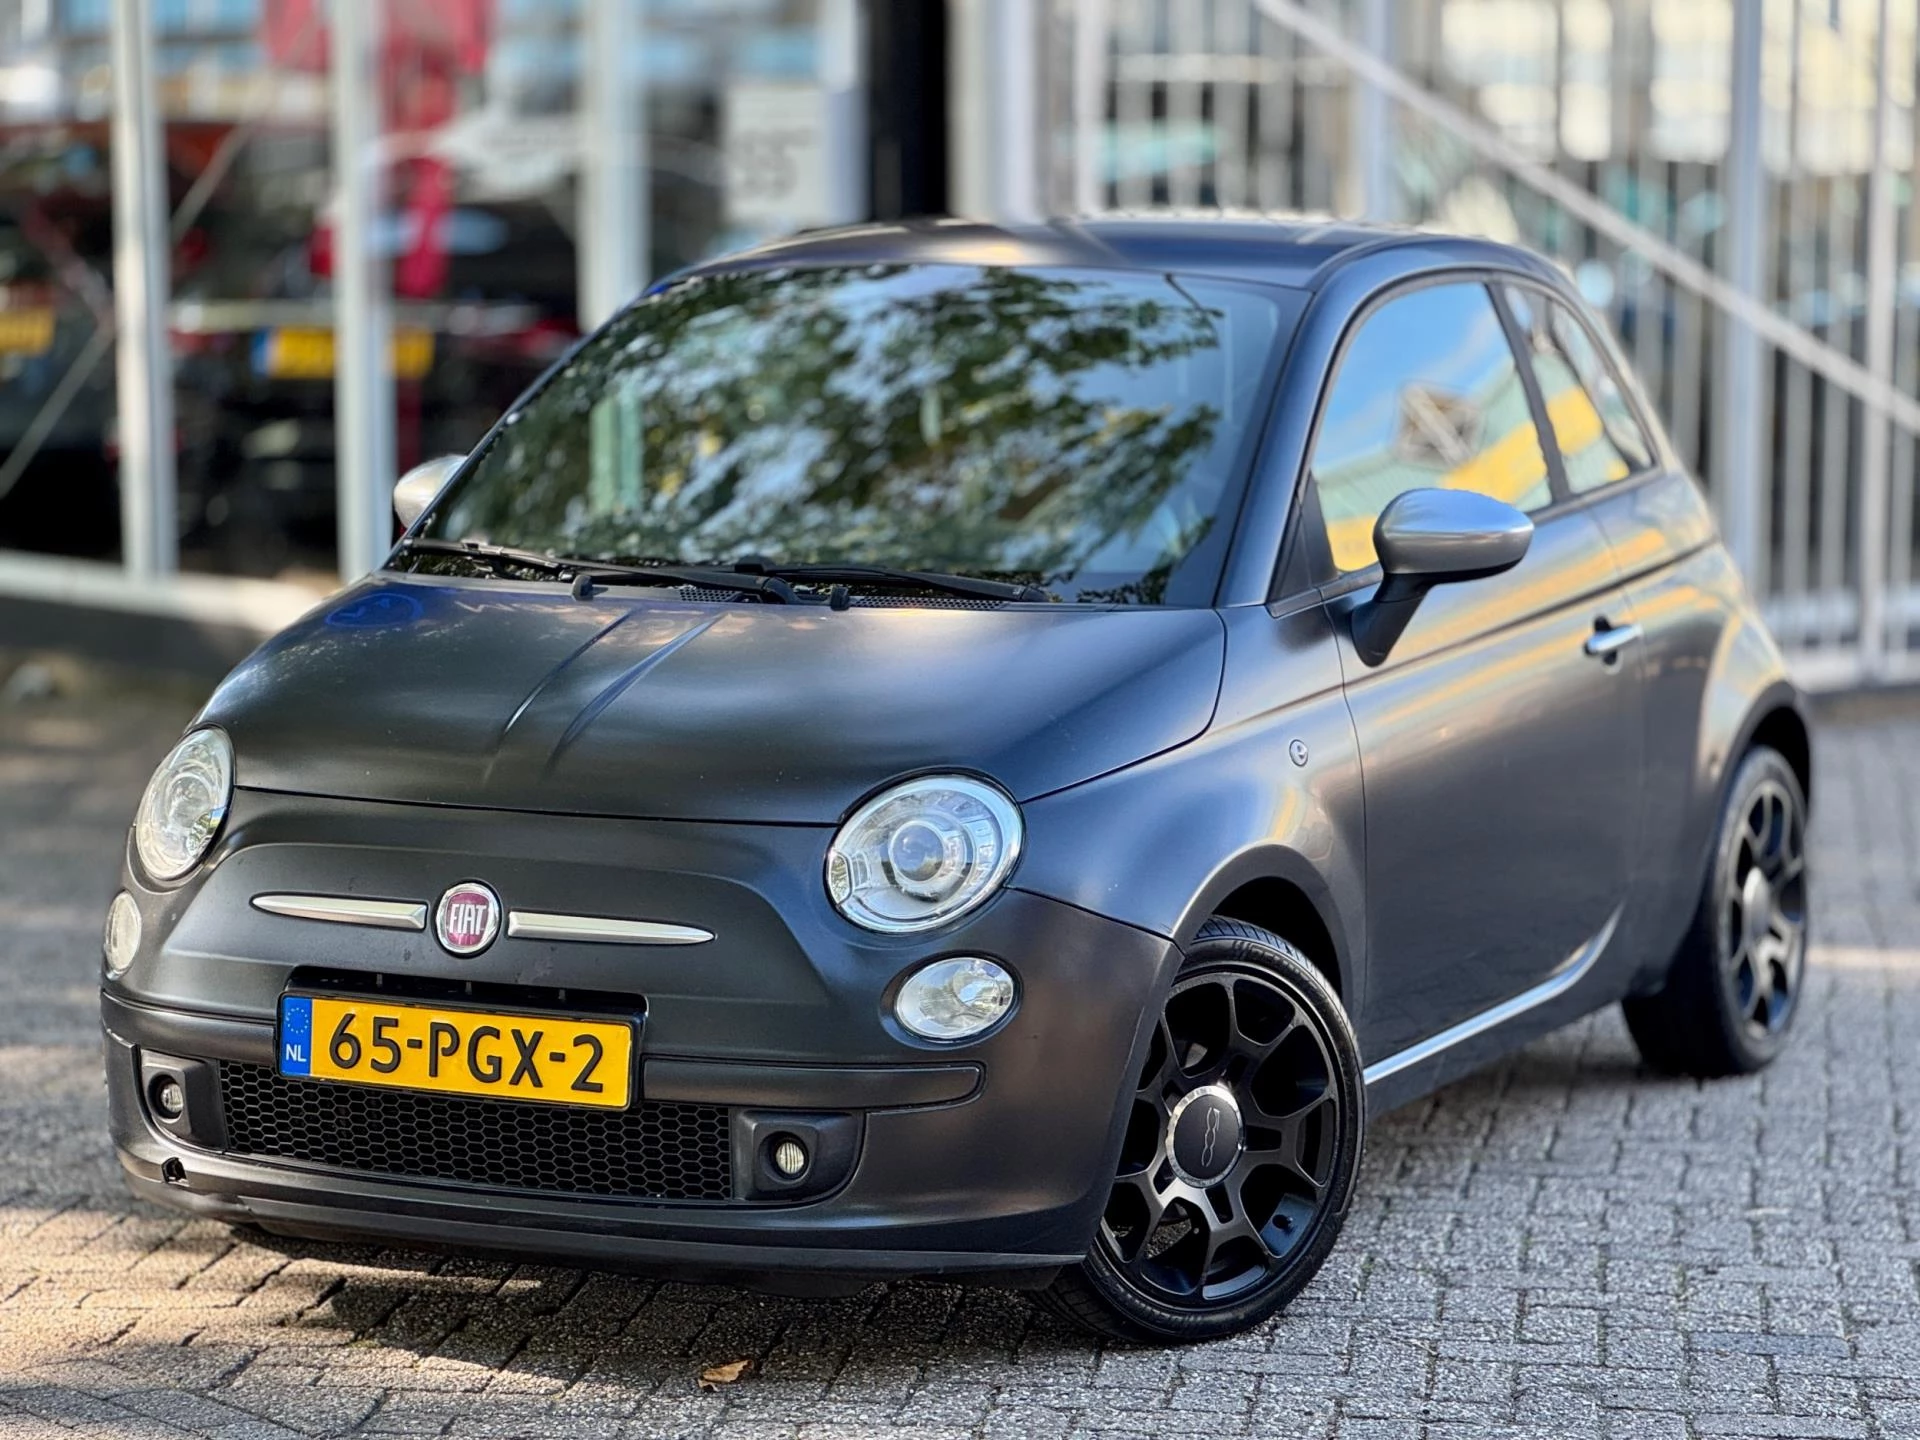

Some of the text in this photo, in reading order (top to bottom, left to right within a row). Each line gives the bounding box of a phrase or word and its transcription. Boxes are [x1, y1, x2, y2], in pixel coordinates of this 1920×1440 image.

[449, 903, 487, 936] FIAT
[285, 1044, 307, 1063] NL
[329, 1012, 604, 1094] 65-PGX-2
